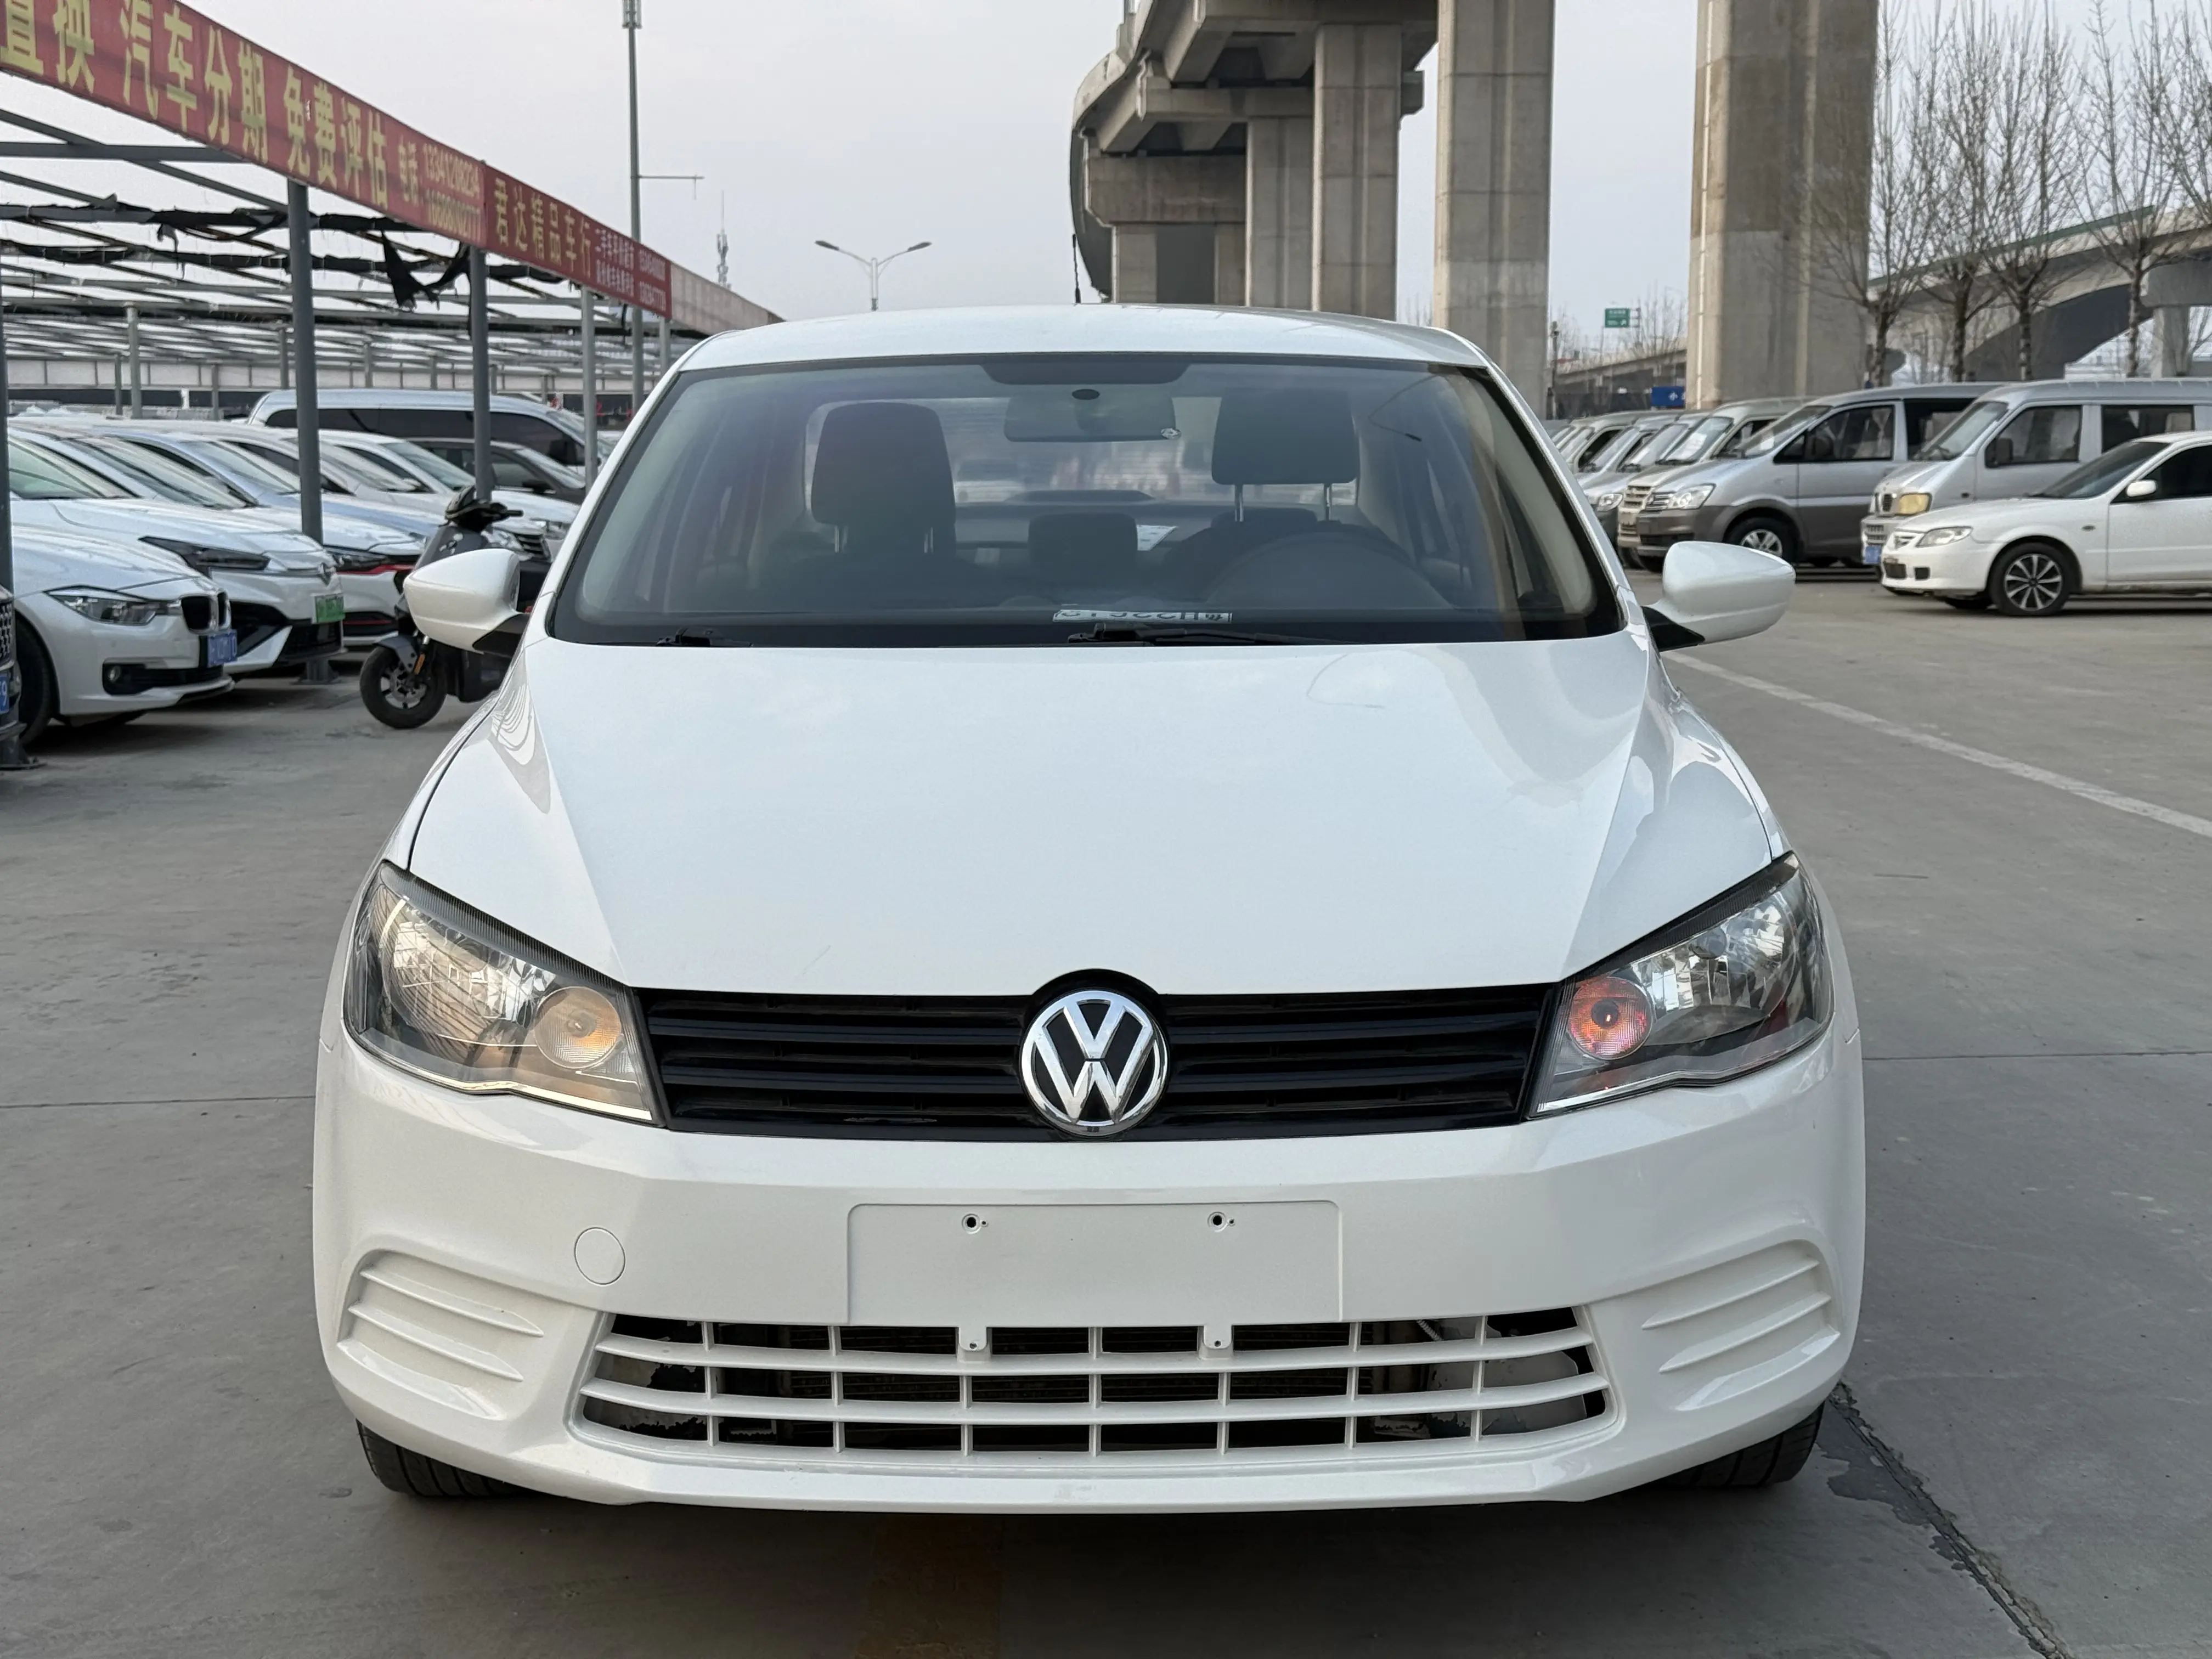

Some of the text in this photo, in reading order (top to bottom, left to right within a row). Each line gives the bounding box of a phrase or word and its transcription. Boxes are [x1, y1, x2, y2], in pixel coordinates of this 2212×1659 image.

[120, 0, 268, 164] 汽车分期
[284, 64, 387, 211] 免费评估
